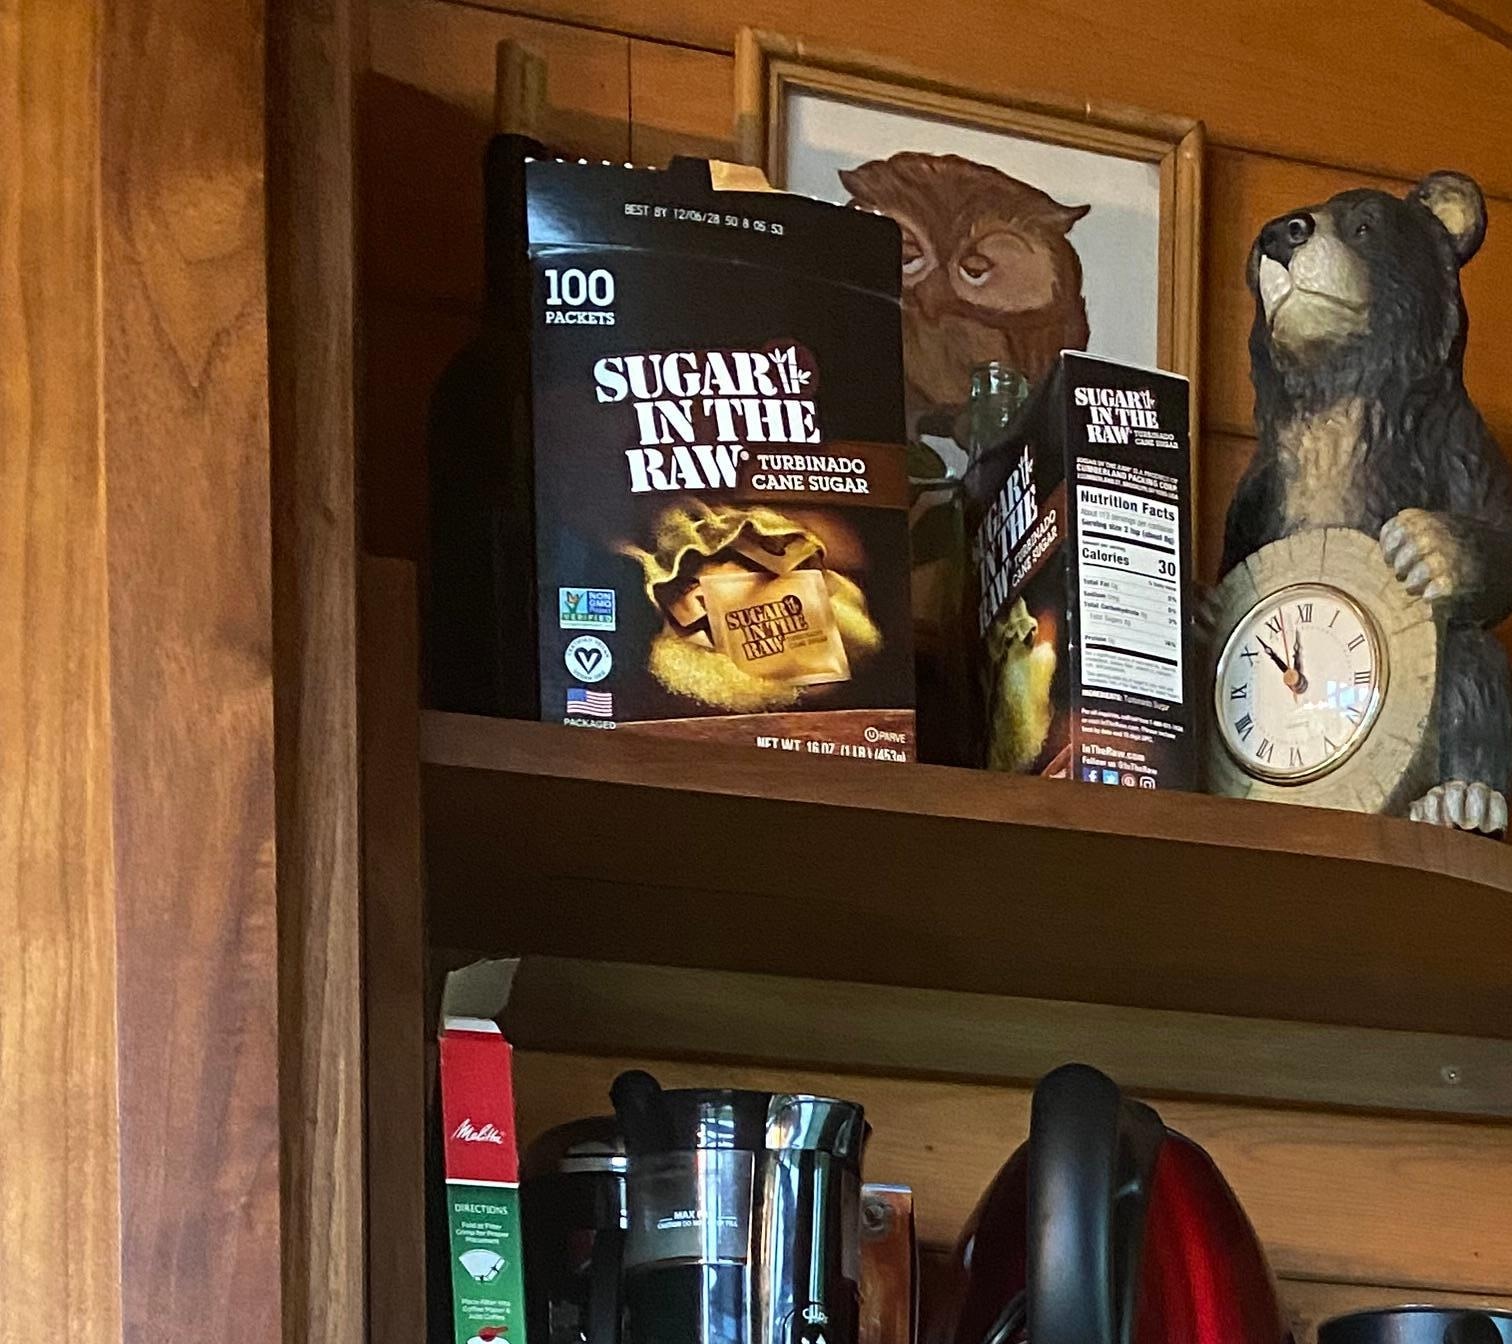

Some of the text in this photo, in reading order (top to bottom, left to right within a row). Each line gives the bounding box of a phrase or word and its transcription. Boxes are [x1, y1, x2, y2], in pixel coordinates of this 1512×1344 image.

[625, 204, 649, 215] BEST
[654, 206, 667, 218] BY
[545, 268, 615, 306] 100
[545, 311, 615, 326] PACKETS
[593, 351, 778, 403] SUGAR
[1074, 387, 1143, 409] SUGAR
[633, 398, 822, 445] IN THE
[1089, 406, 1160, 430] IN THE
[1086, 424, 1130, 445] RAW
[624, 445, 746, 493] RAW
[757, 454, 866, 475] TURBINADO
[751, 474, 870, 495] CANE SUGAR
[1080, 490, 1176, 522] Nutrition Facts
[1082, 547, 1176, 577] Calories 30
[589, 591, 611, 600] NON
[589, 599, 612, 608] GMO
[726, 602, 790, 629] SUGAR
[741, 620, 767, 641] IN
[765, 614, 809, 637] THE
[743, 636, 785, 660] RAW
[563, 717, 618, 731] PACKAGED
[780, 738, 801, 752] WT
[450, 1118, 503, 1145] Melitta
[454, 1203, 509, 1215] DIRECTIONS
[673, 1210, 695, 1220] MAX
